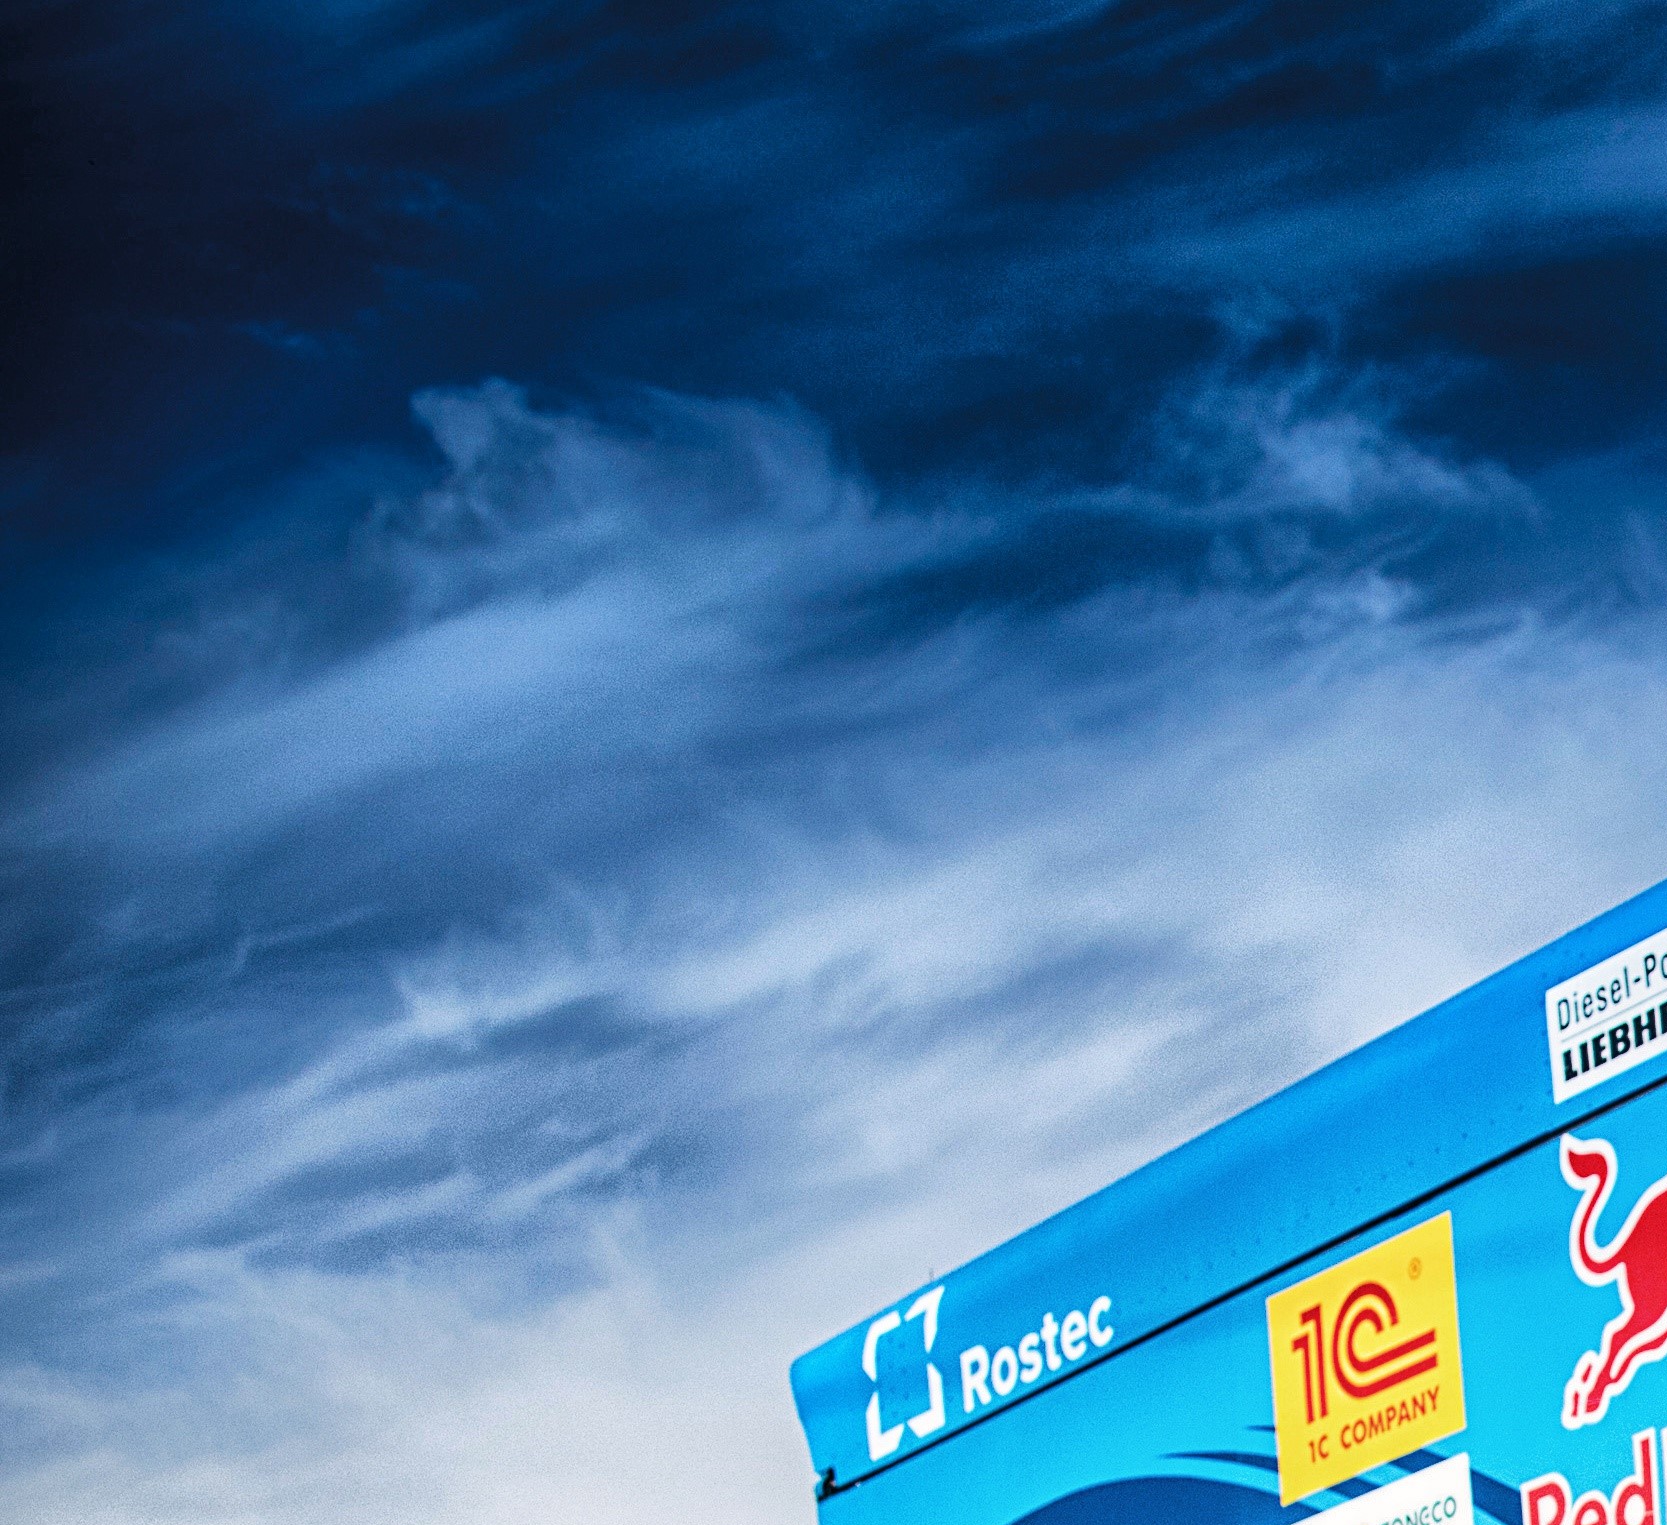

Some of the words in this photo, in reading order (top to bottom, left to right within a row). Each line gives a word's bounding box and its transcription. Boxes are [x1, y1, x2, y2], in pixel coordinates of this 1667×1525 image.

[960, 1295, 1115, 1413] Rostec
[1307, 1433, 1330, 1464] 1C
[1339, 1384, 1440, 1451] COMPANY
